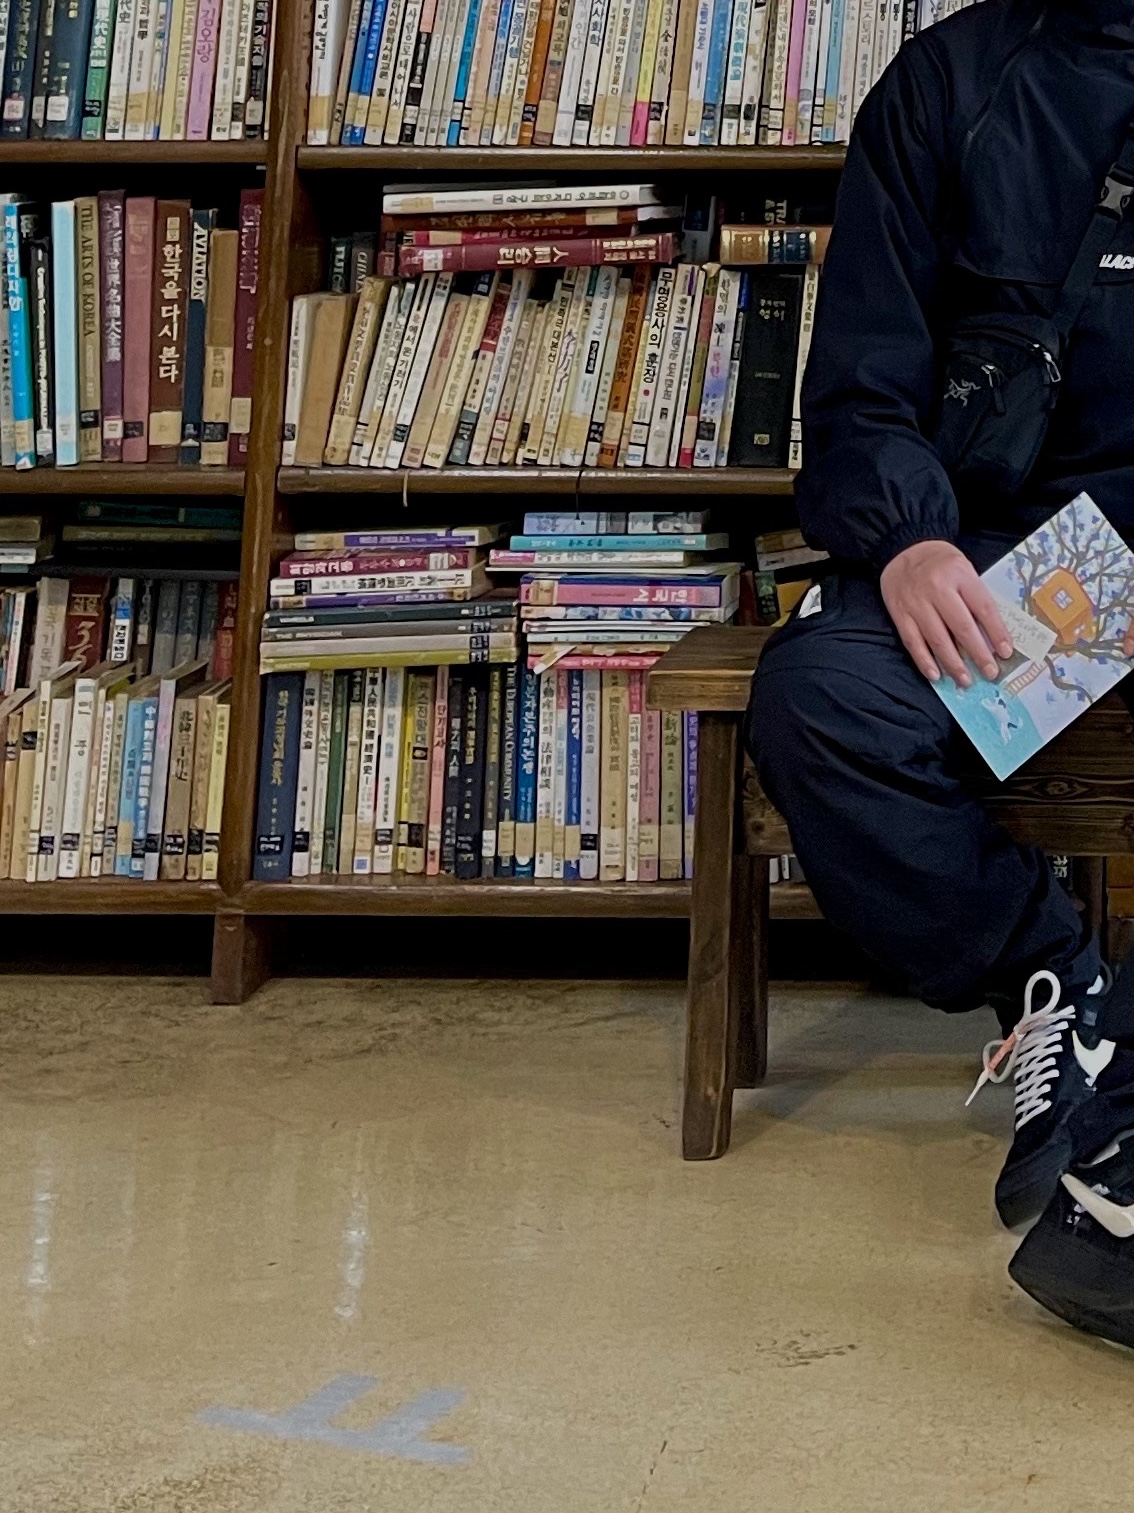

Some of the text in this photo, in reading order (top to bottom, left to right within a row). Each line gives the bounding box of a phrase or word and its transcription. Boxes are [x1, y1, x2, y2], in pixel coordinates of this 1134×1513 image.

[158, 243, 182, 384] 한국을 다시 본다
